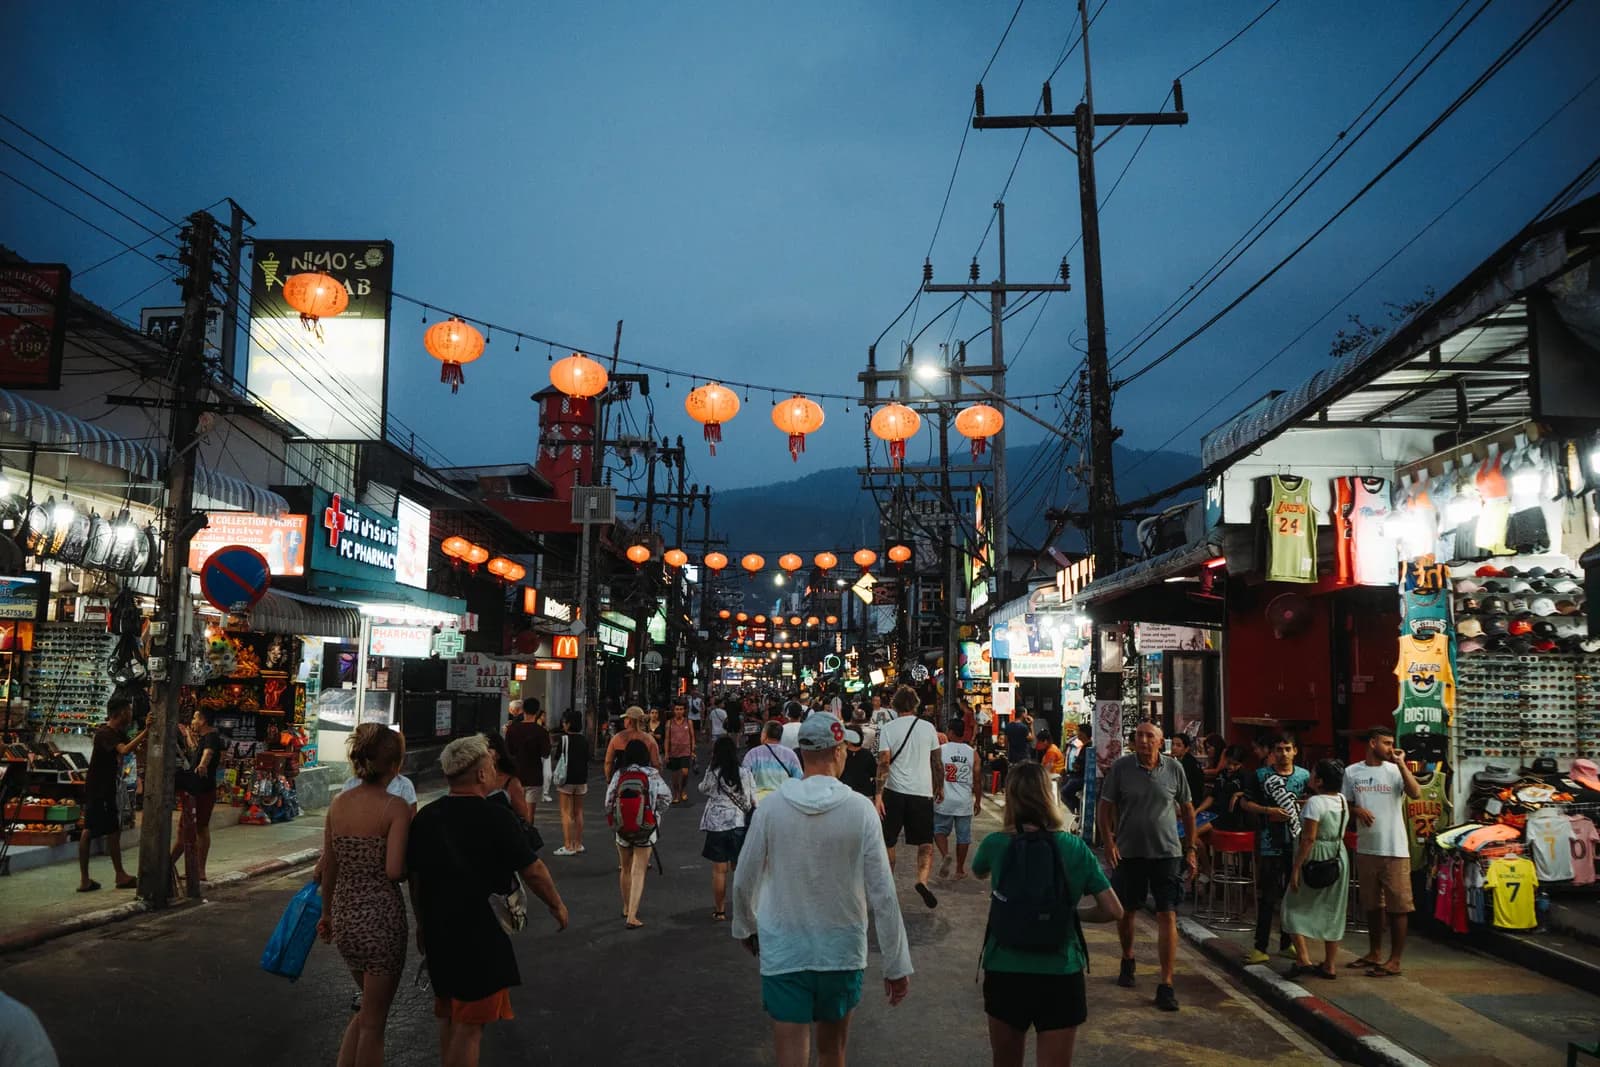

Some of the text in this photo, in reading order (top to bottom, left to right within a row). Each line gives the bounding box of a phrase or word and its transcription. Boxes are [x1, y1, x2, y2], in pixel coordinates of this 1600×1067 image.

[341, 539, 353, 558] PC
[1404, 706, 1442, 724] BOSTON
[944, 763, 971, 784] 22
[1407, 801, 1441, 819] BULLS
[1506, 882, 1521, 903] 7
